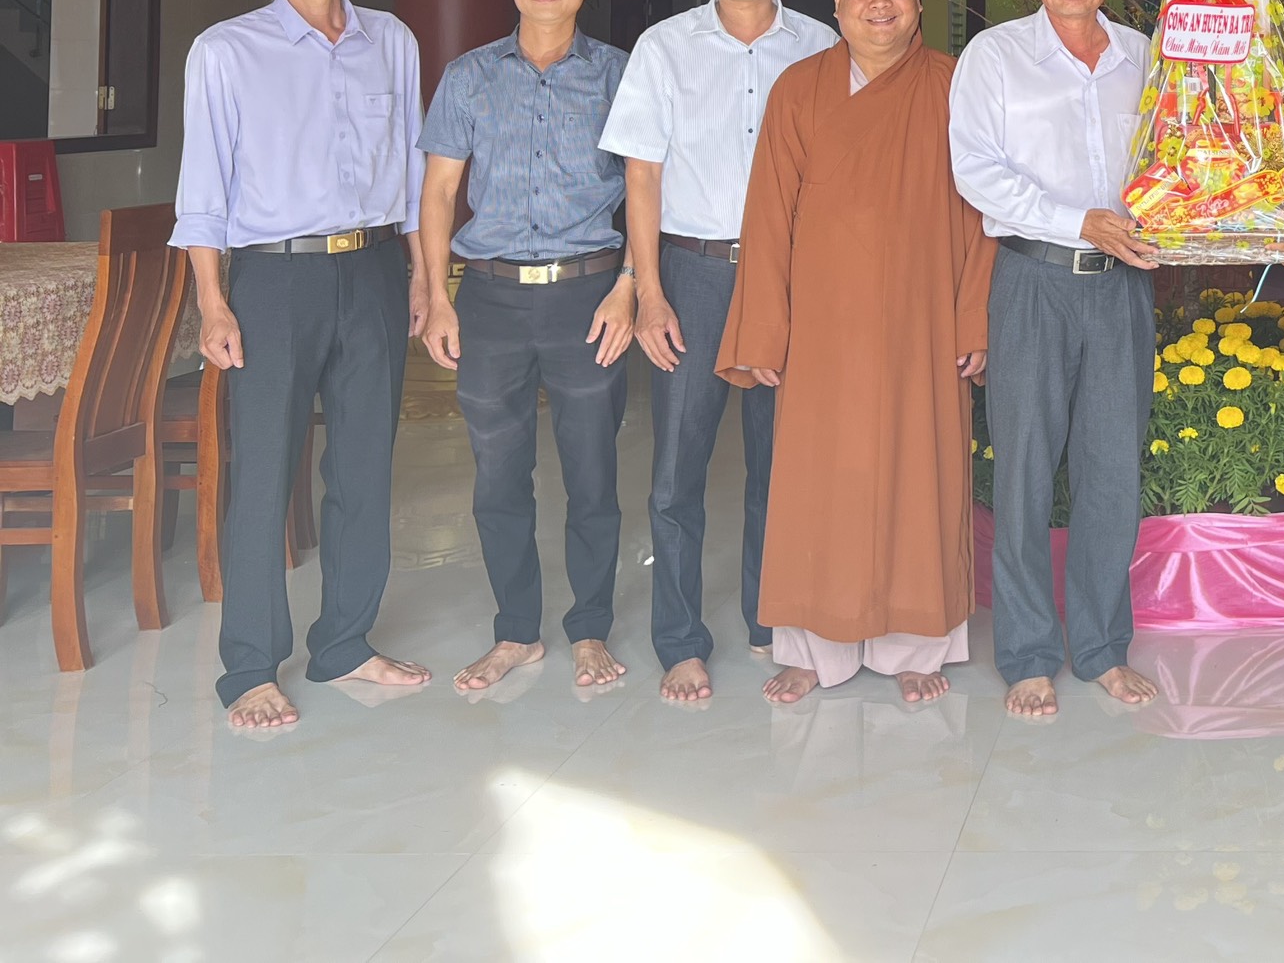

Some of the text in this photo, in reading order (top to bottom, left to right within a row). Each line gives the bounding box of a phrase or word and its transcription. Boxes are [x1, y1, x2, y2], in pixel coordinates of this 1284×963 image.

[1168, 7, 1189, 31] CÔNG
[1189, 13, 1202, 32] AN
[1201, 9, 1229, 39] HUYỆN
[1228, 15, 1239, 34] BA
[1165, 36, 1247, 57] Chúc Mừng Năm Mới
